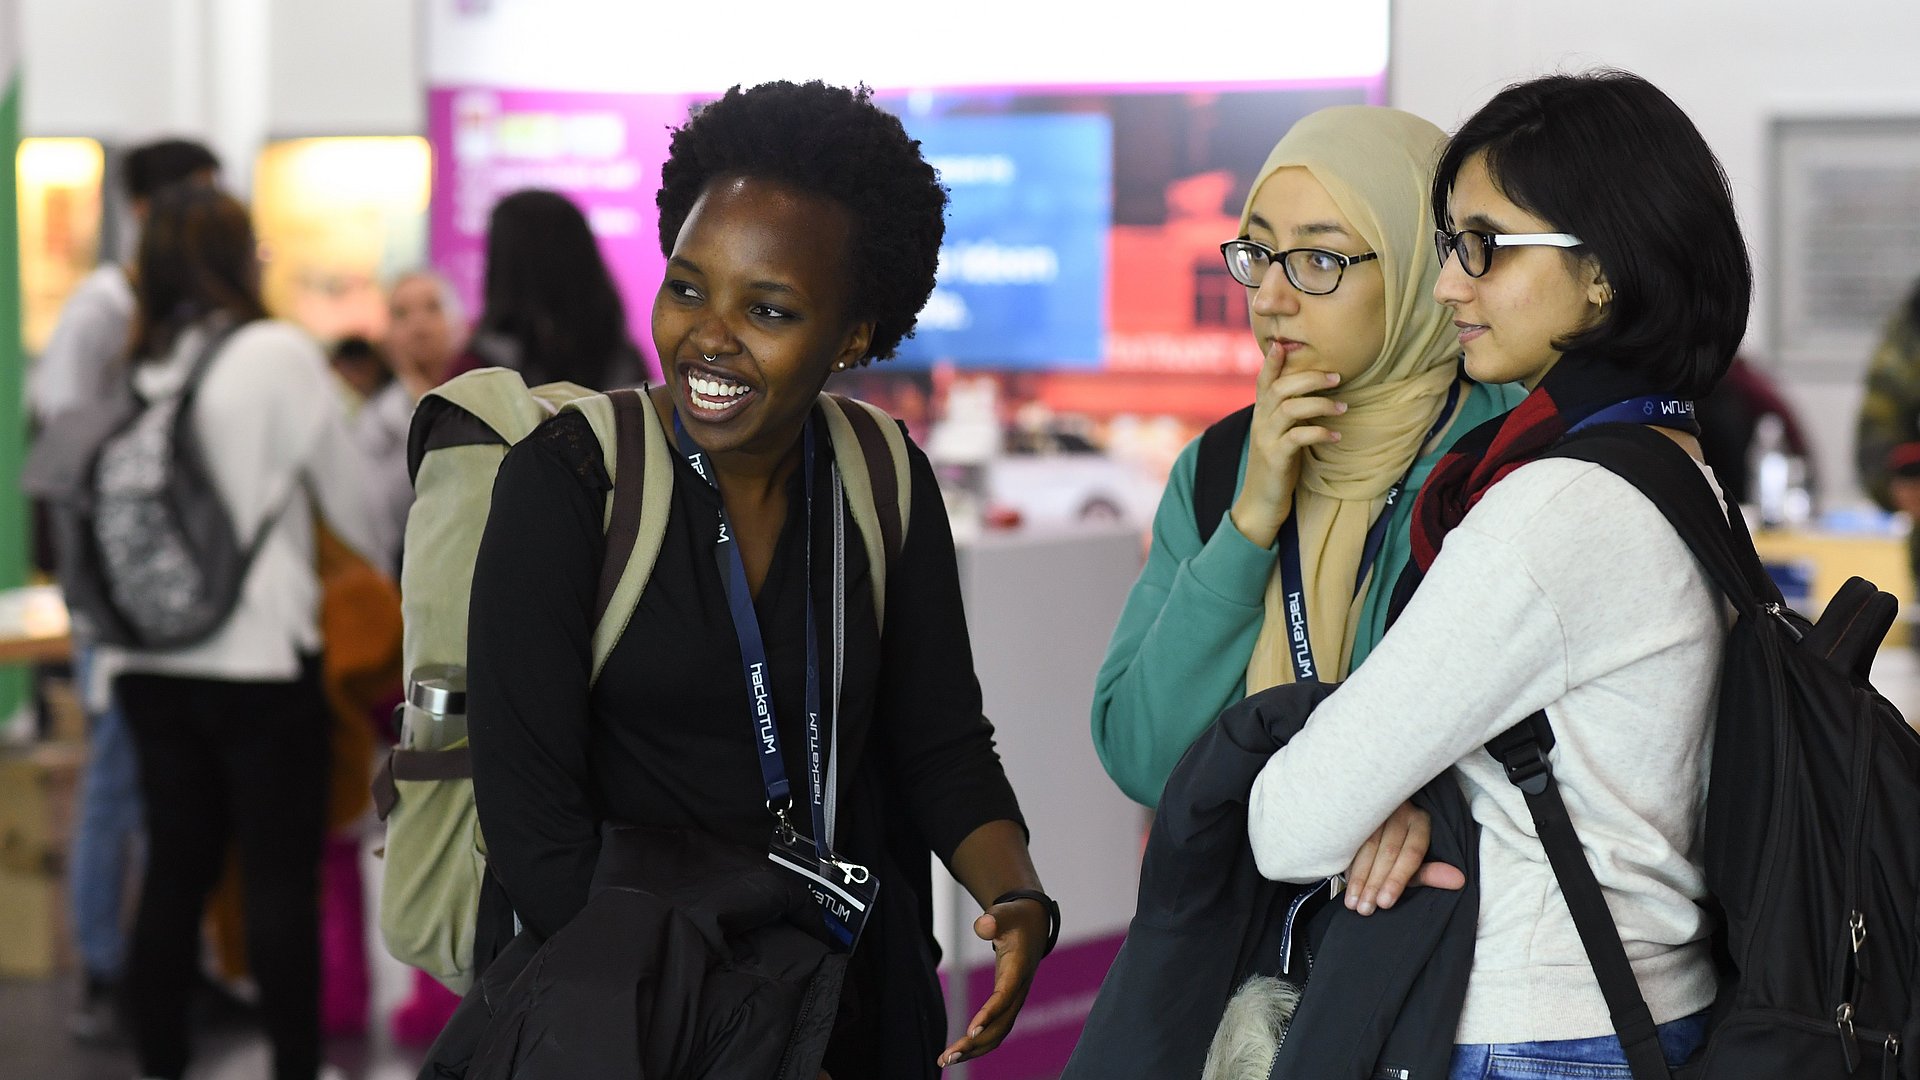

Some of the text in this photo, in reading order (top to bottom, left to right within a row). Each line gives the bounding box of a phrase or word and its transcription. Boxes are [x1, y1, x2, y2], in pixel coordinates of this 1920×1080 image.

[1661, 400, 1694, 415] aTUM
[1288, 591, 1313, 678] hackaTUM
[750, 662, 777, 754] hackaTUM
[809, 712, 823, 805] hackaTUM
[808, 883, 851, 923] aTUM
